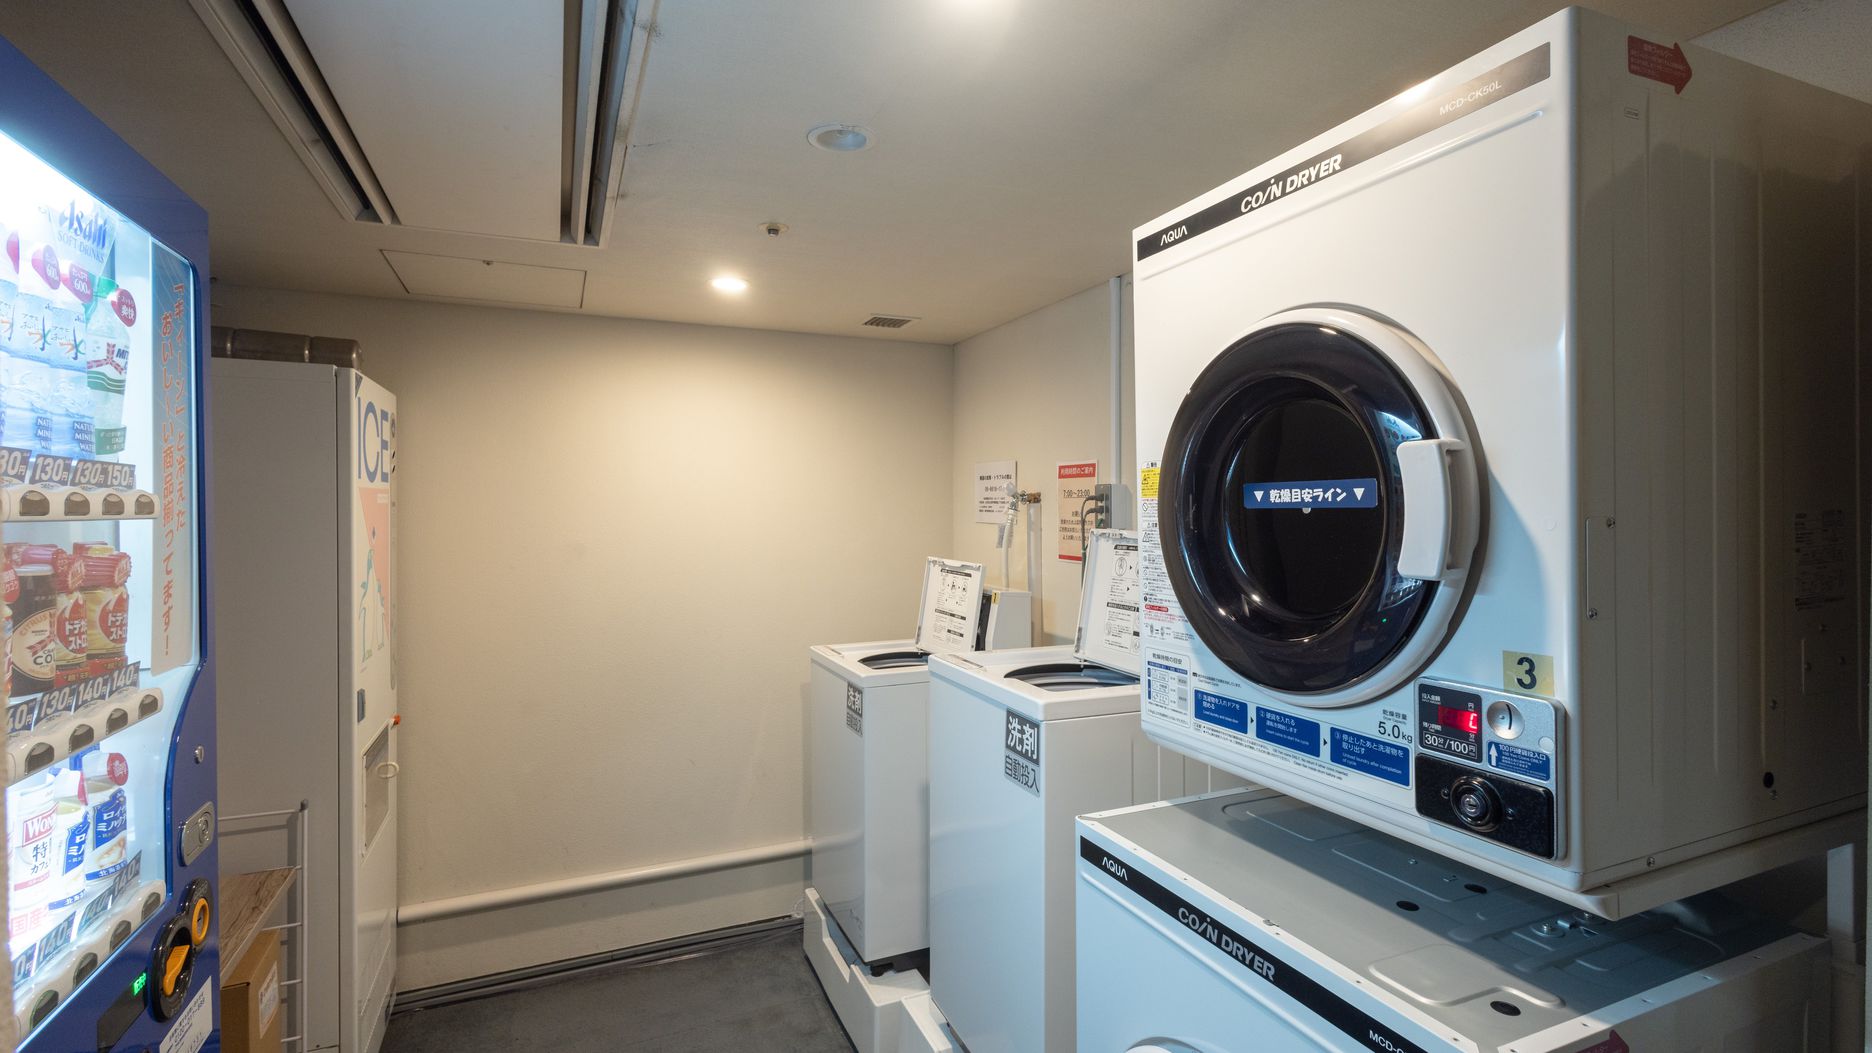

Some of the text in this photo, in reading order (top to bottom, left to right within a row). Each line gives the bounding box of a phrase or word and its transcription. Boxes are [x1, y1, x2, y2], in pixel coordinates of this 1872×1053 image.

[1439, 80, 1503, 116] MCD-CK50L
[1240, 153, 1343, 214] COIN DRYER
[1160, 225, 1188, 247] AQUA
[357, 396, 389, 484] ICE
[1269, 488, 1347, 503] 乾燥目安ライン
[1516, 656, 1537, 690] 3
[1007, 715, 1038, 760] 洗剤
[1004, 755, 1040, 793] 自動投入
[1102, 855, 1128, 881] AQUA
[1178, 907, 1276, 982] COIN DRYER
